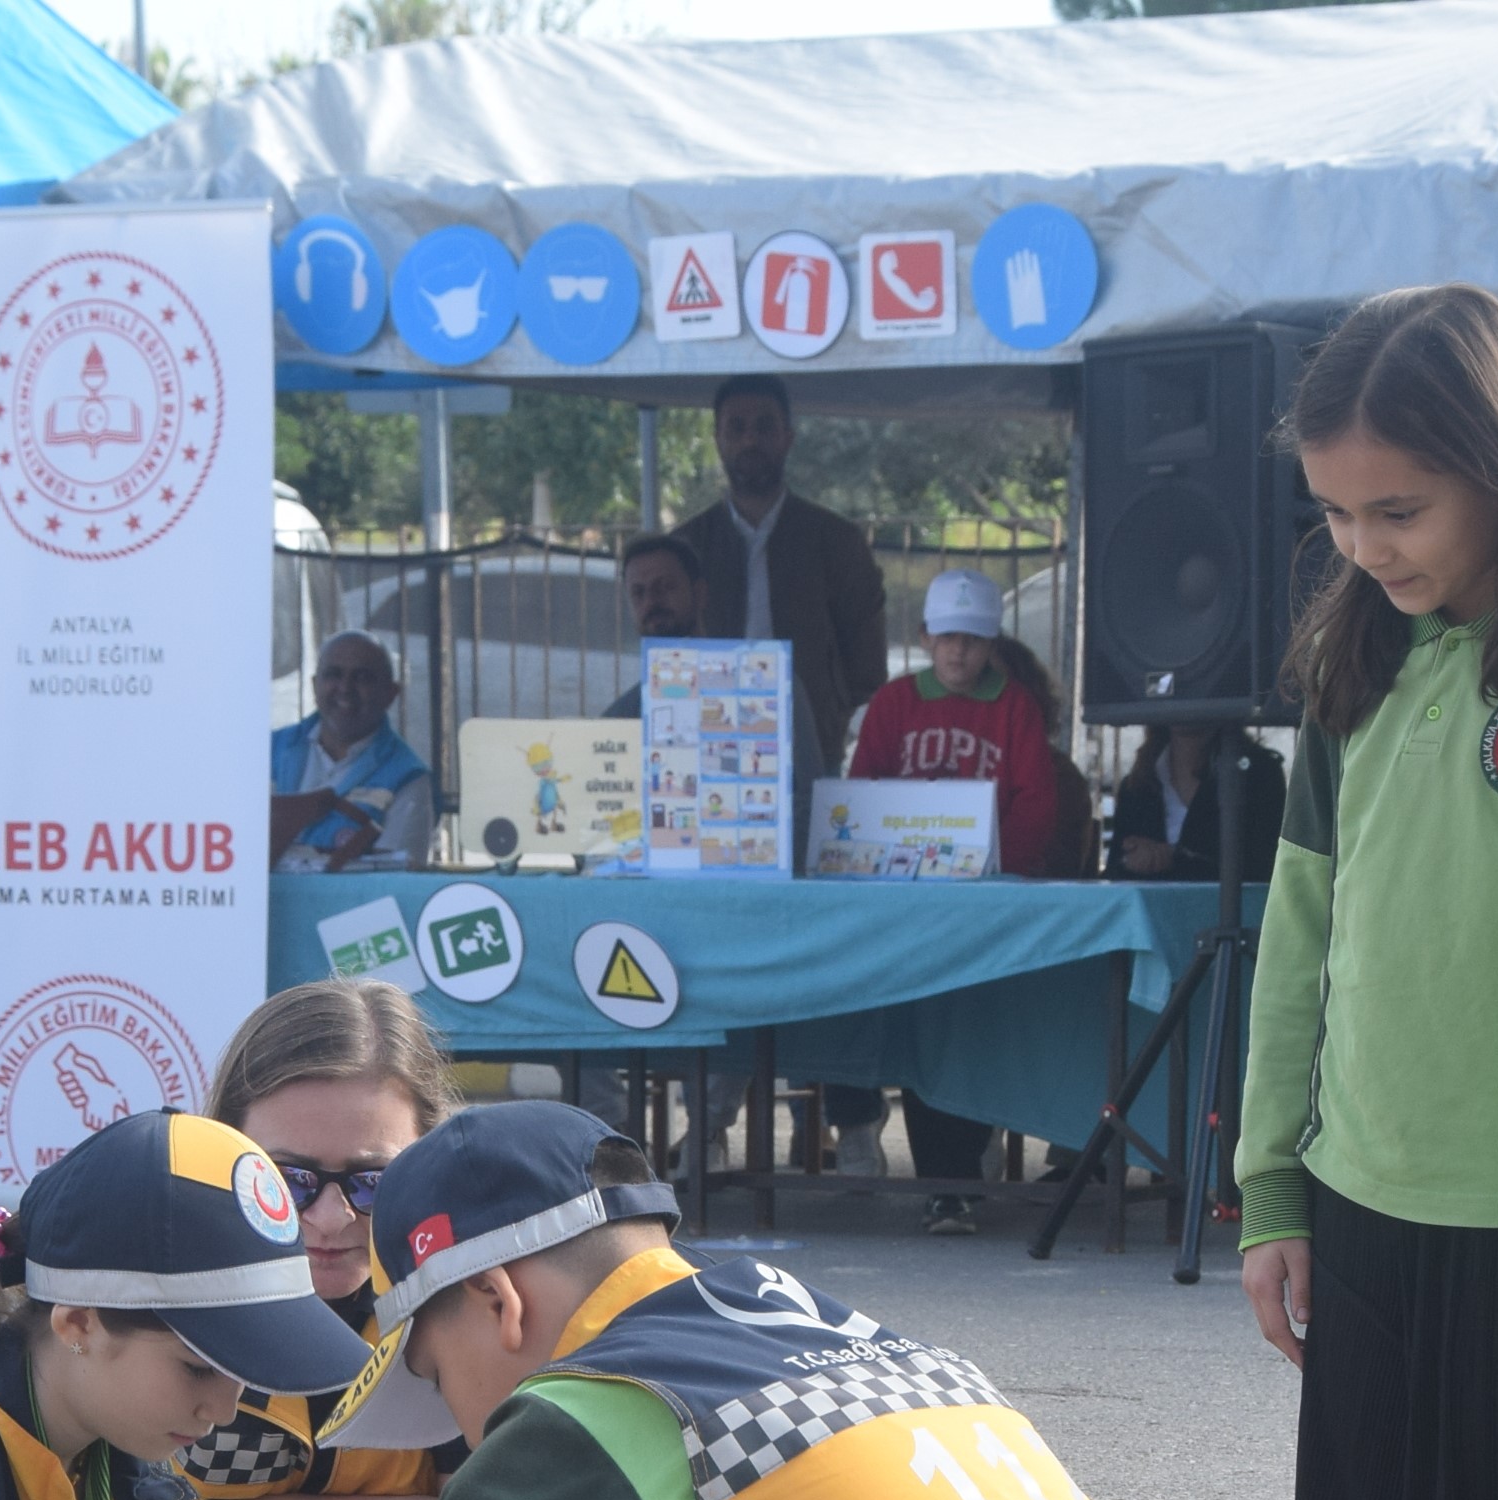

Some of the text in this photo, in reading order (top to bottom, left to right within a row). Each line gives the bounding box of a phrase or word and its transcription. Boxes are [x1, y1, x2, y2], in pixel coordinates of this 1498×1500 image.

[50, 615, 134, 634] ANTALYA
[16, 643, 164, 665] İL MİLLİ EĞİTİM
[29, 673, 154, 696] MÜDÜRLÜĞÜ
[82, 822, 235, 874] AKUB
[41, 886, 152, 906] KURTAMA
[161, 885, 235, 907] BİRİMİ
[39, 1000, 118, 1034] EĞİTİM
